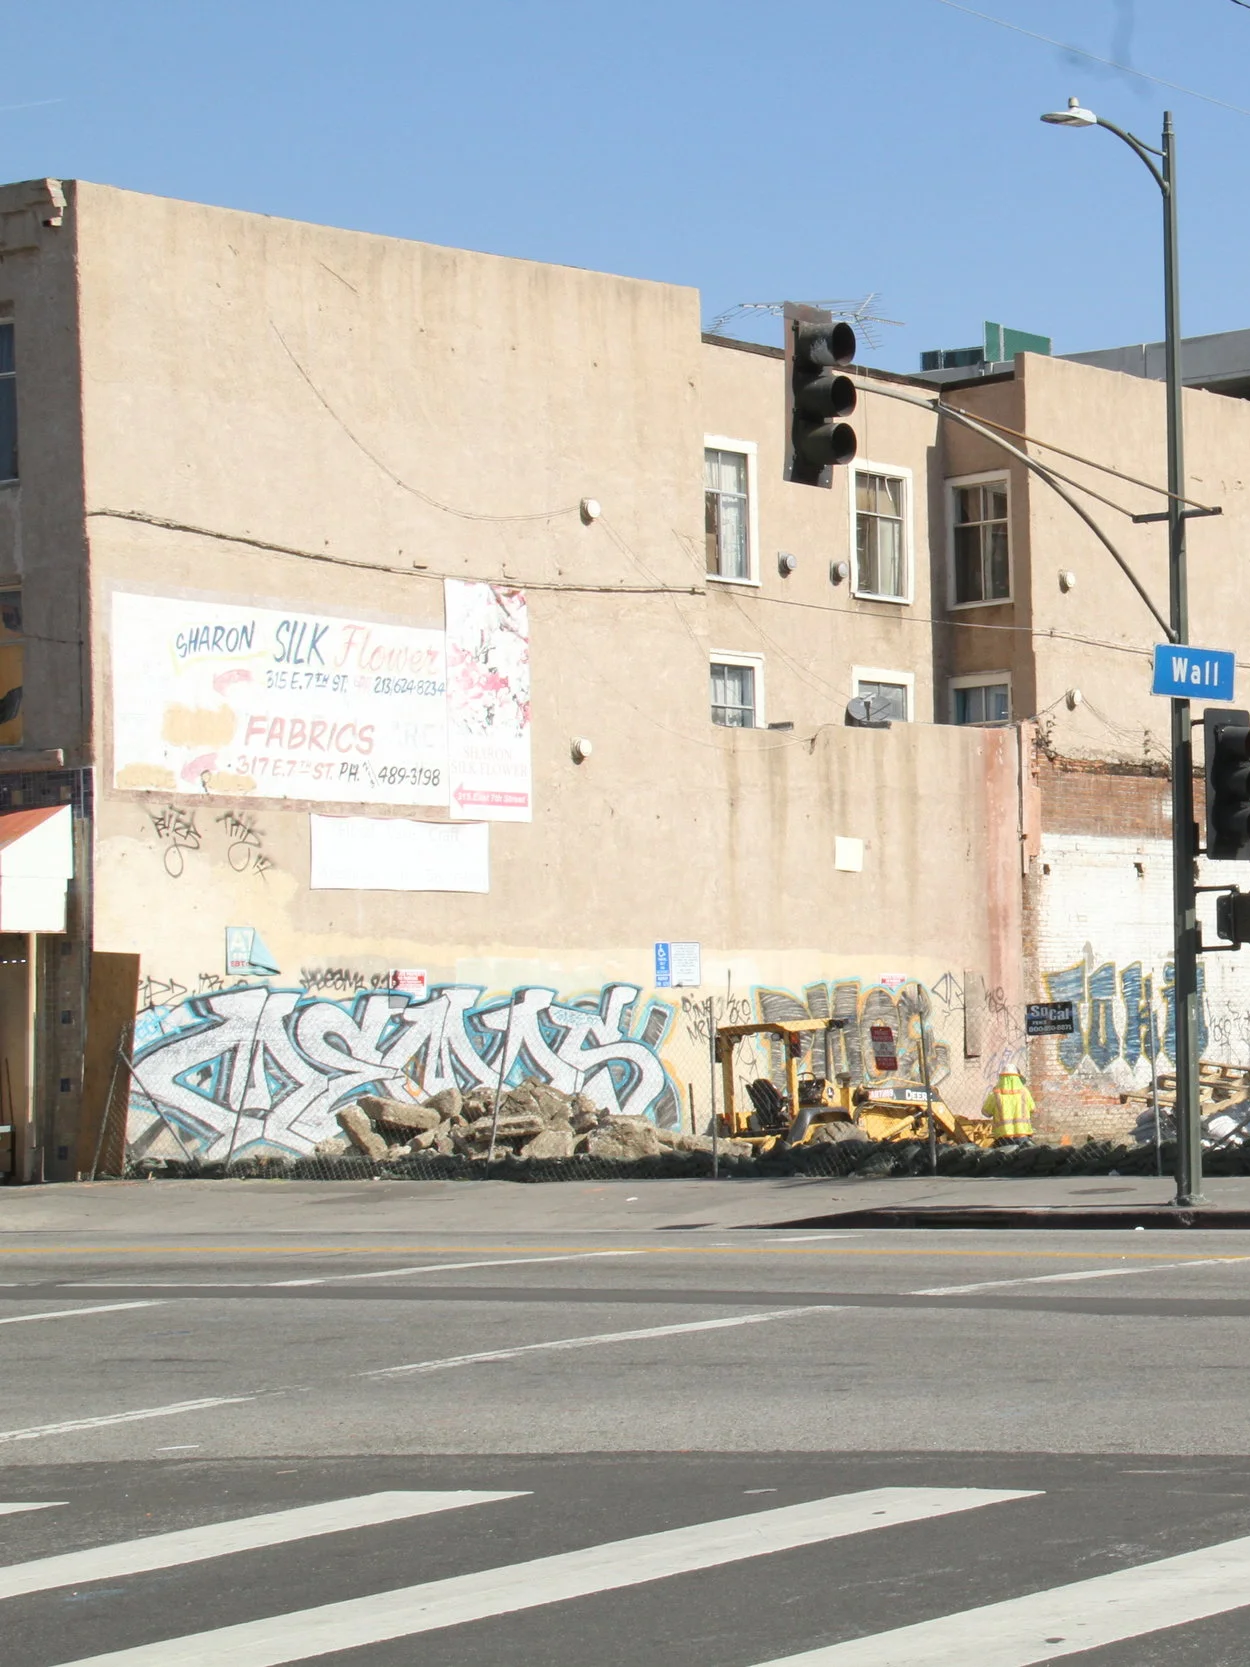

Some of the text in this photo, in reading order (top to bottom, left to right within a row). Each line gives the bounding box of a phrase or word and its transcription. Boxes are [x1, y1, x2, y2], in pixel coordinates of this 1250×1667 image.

[175, 619, 440, 675] SHARON SILK Flower
[266, 669, 289, 689] 315
[1172, 656, 1219, 686] Wall
[244, 714, 376, 755] FABRICS
[236, 755, 270, 776] 317
[377, 766, 441, 787] 489-3198
[905, 1090, 932, 1102] DEER
